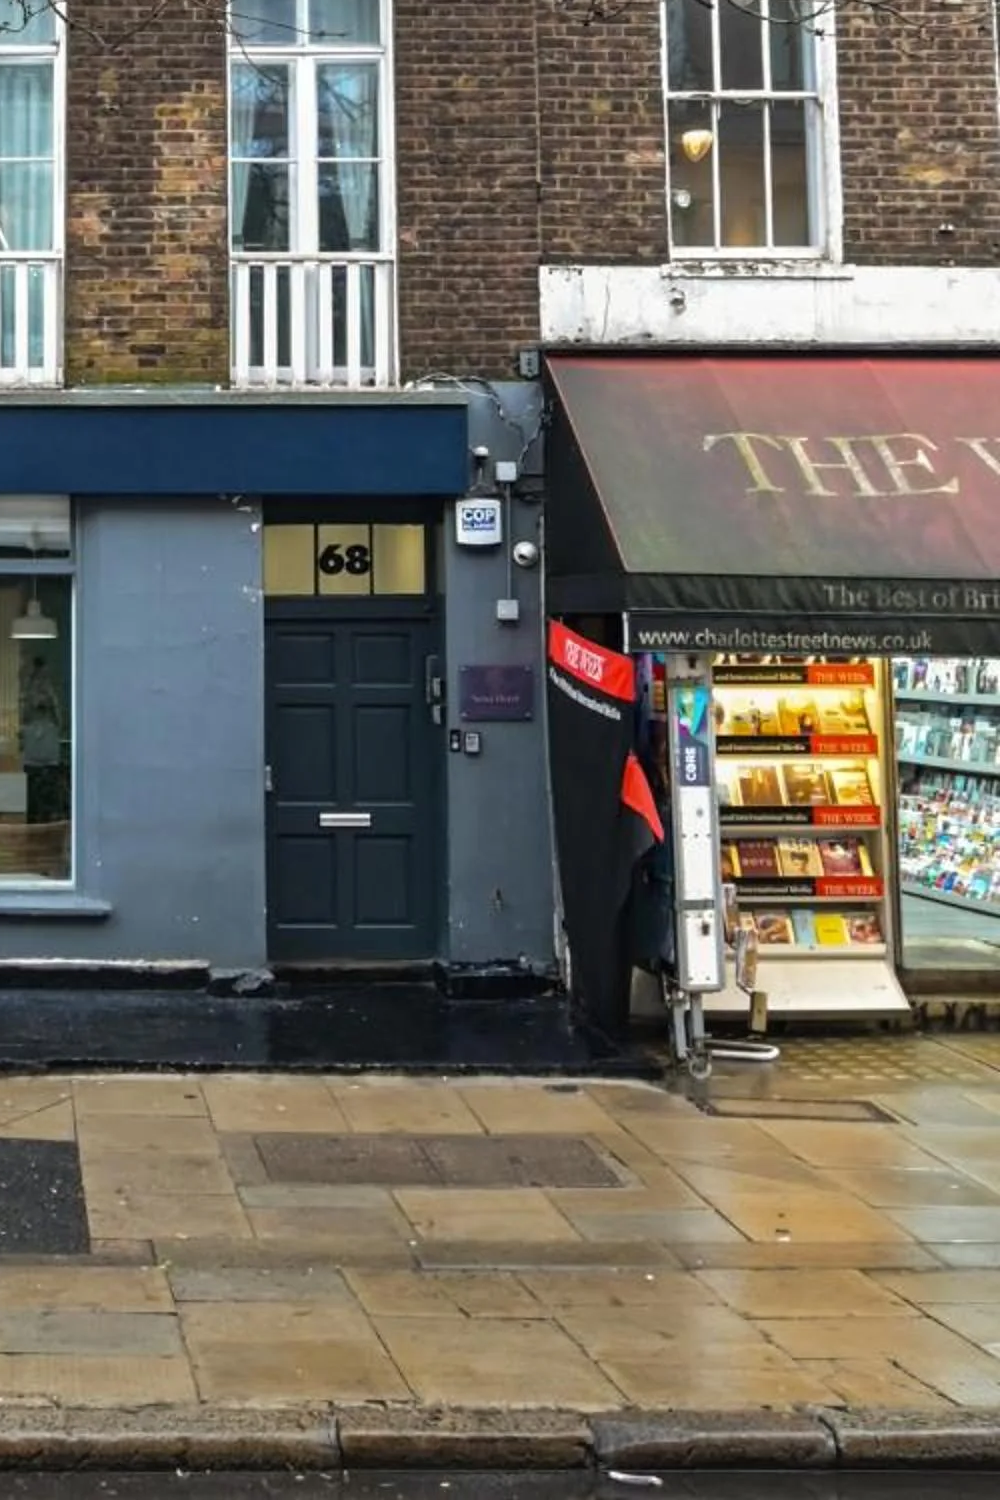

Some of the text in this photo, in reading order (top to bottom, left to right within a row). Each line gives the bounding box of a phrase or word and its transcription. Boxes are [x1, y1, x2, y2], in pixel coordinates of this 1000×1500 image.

[703, 432, 959, 496] THE
[463, 509, 495, 520] COP
[319, 544, 370, 575] 68
[823, 584, 871, 607] The
[876, 586, 926, 608] Best
[932, 587, 959, 608] of
[638, 628, 933, 650] www.charlottestreetnews.co.uk
